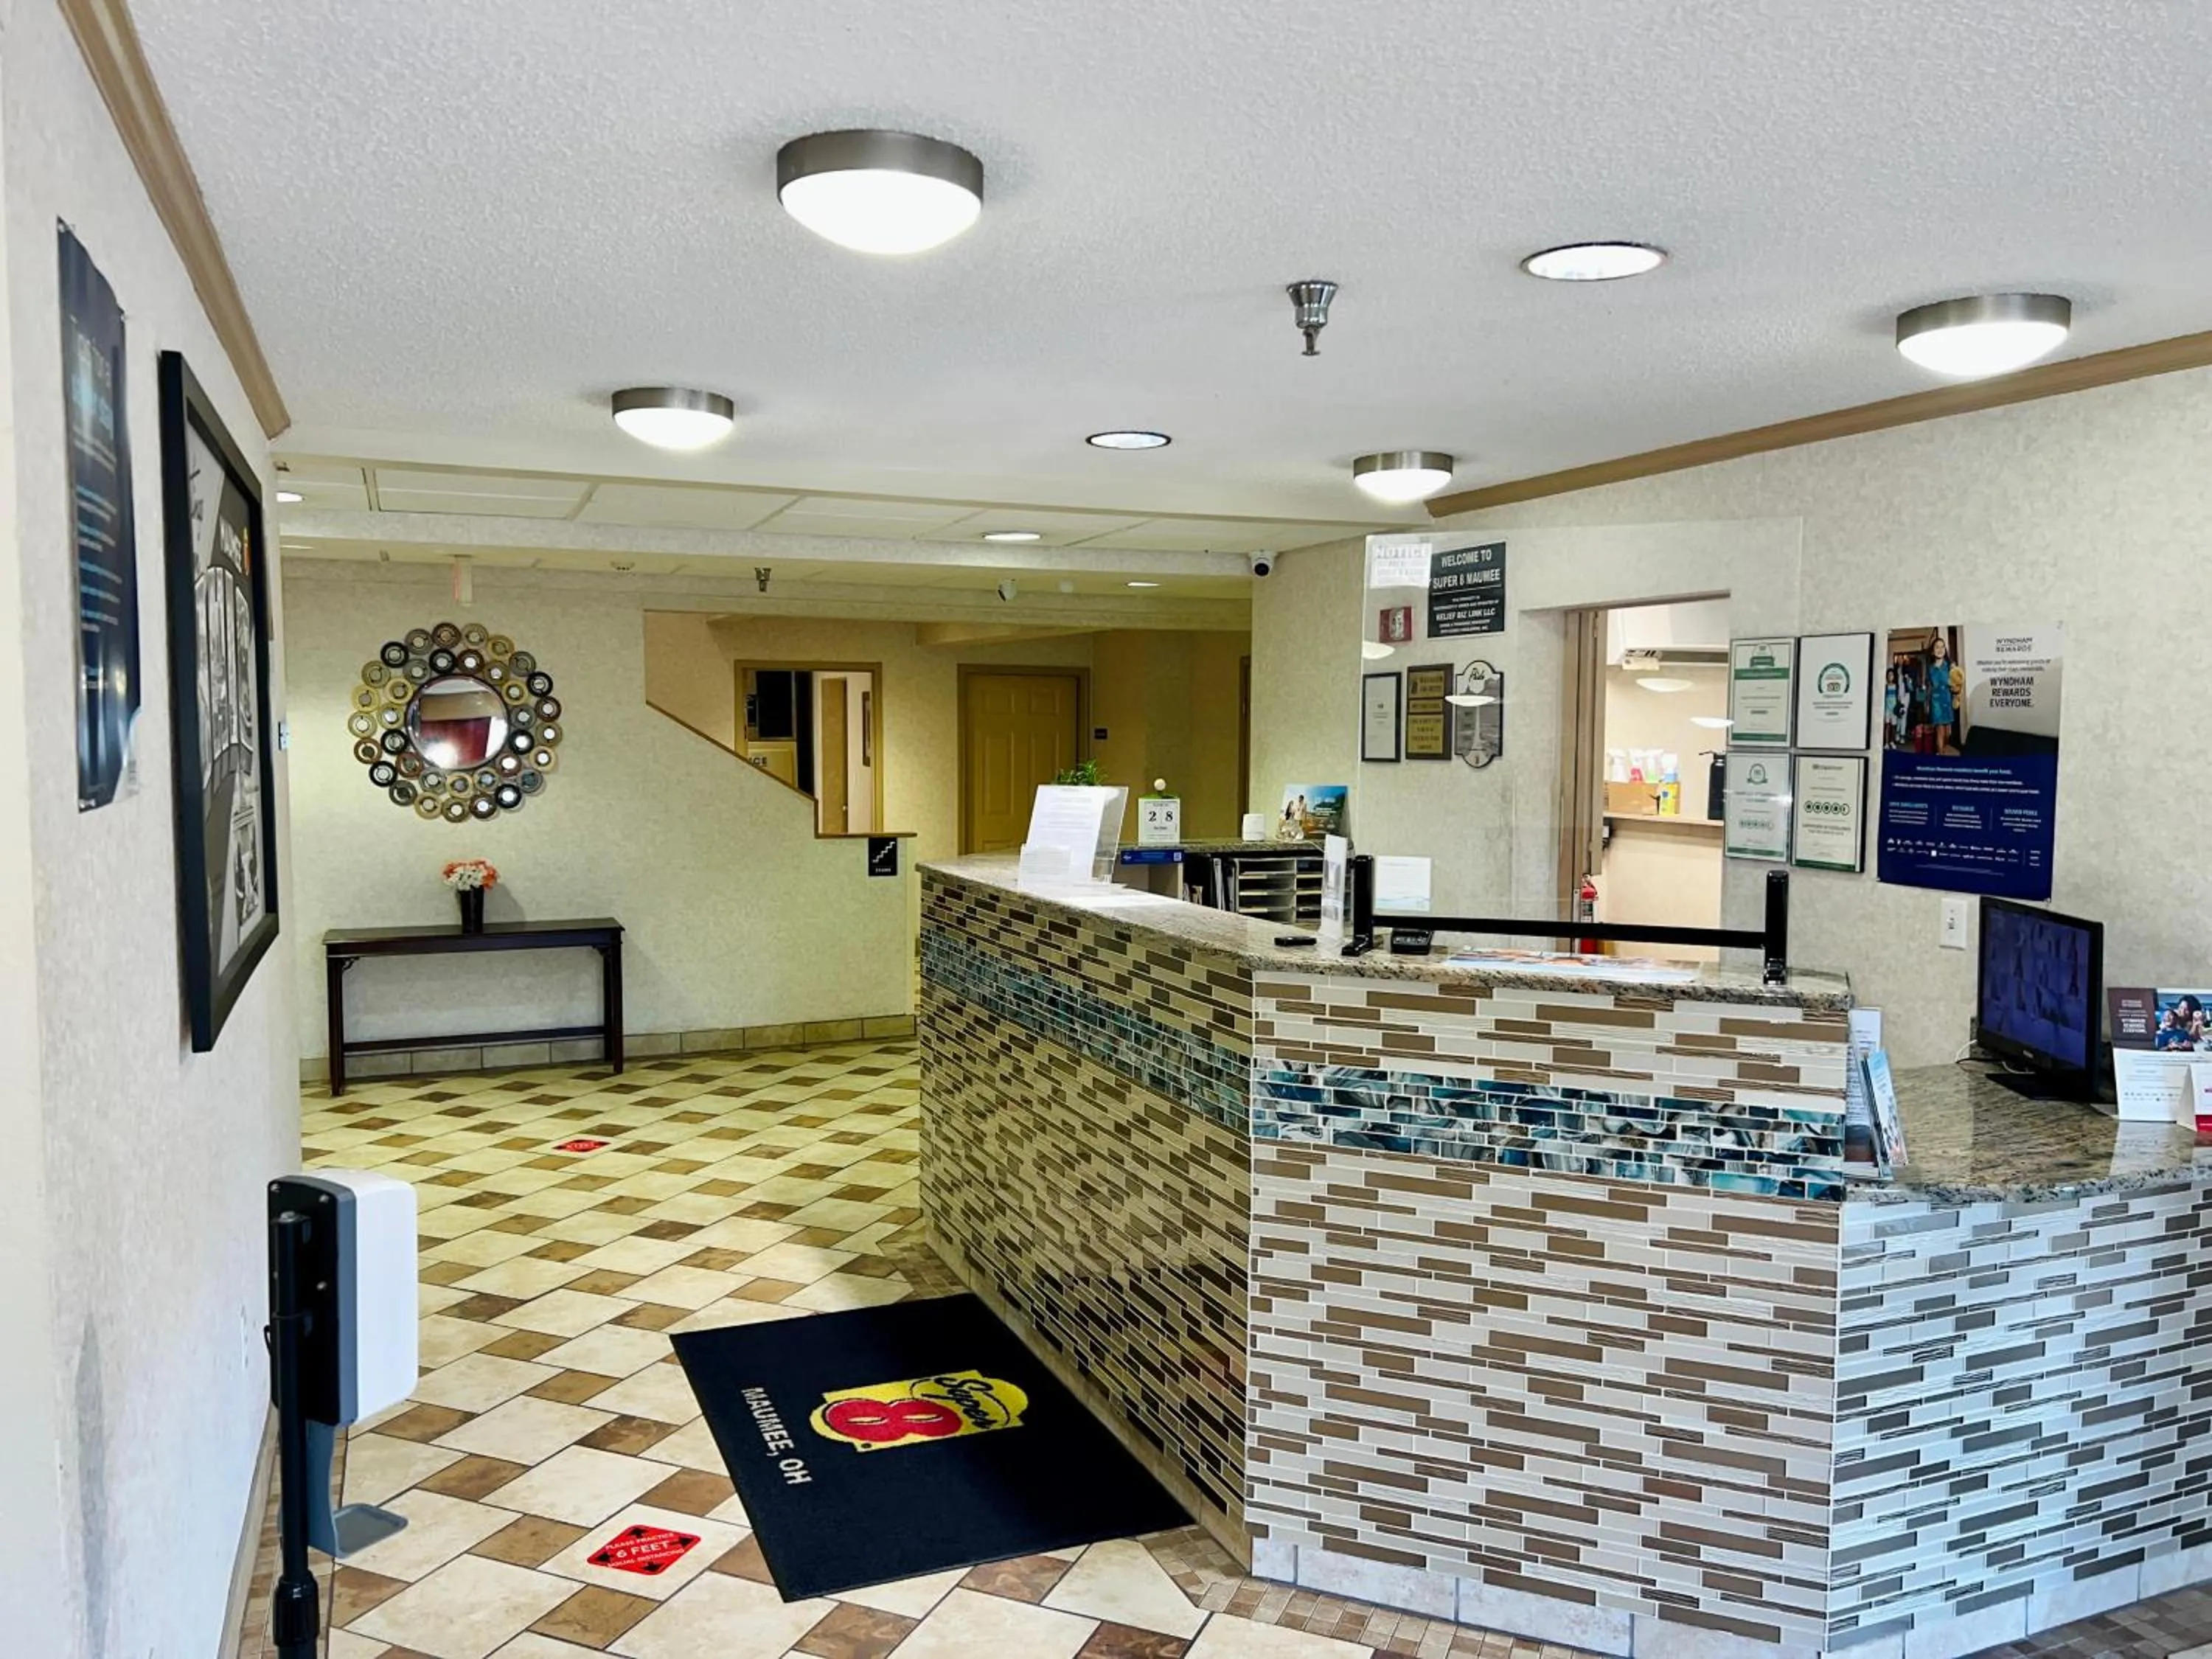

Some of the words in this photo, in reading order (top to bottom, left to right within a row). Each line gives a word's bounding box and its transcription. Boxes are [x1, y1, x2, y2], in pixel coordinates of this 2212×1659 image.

[1441, 551, 1479, 568] WELCOME
[1481, 549, 1492, 561] TO
[1433, 575, 1458, 589] SUPER
[1466, 568, 1500, 585] MAUMEE
[1991, 677, 2034, 686] WYNDHAM
[1992, 688, 2031, 697] REWARDS
[1990, 698, 2034, 708] EVERYONE.
[1148, 810, 1157, 822] 2
[1165, 810, 1174, 822] 8
[740, 1387, 795, 1456] MAUMEE,
[778, 1458, 813, 1484] OH
[630, 1540, 670, 1555] FEET
